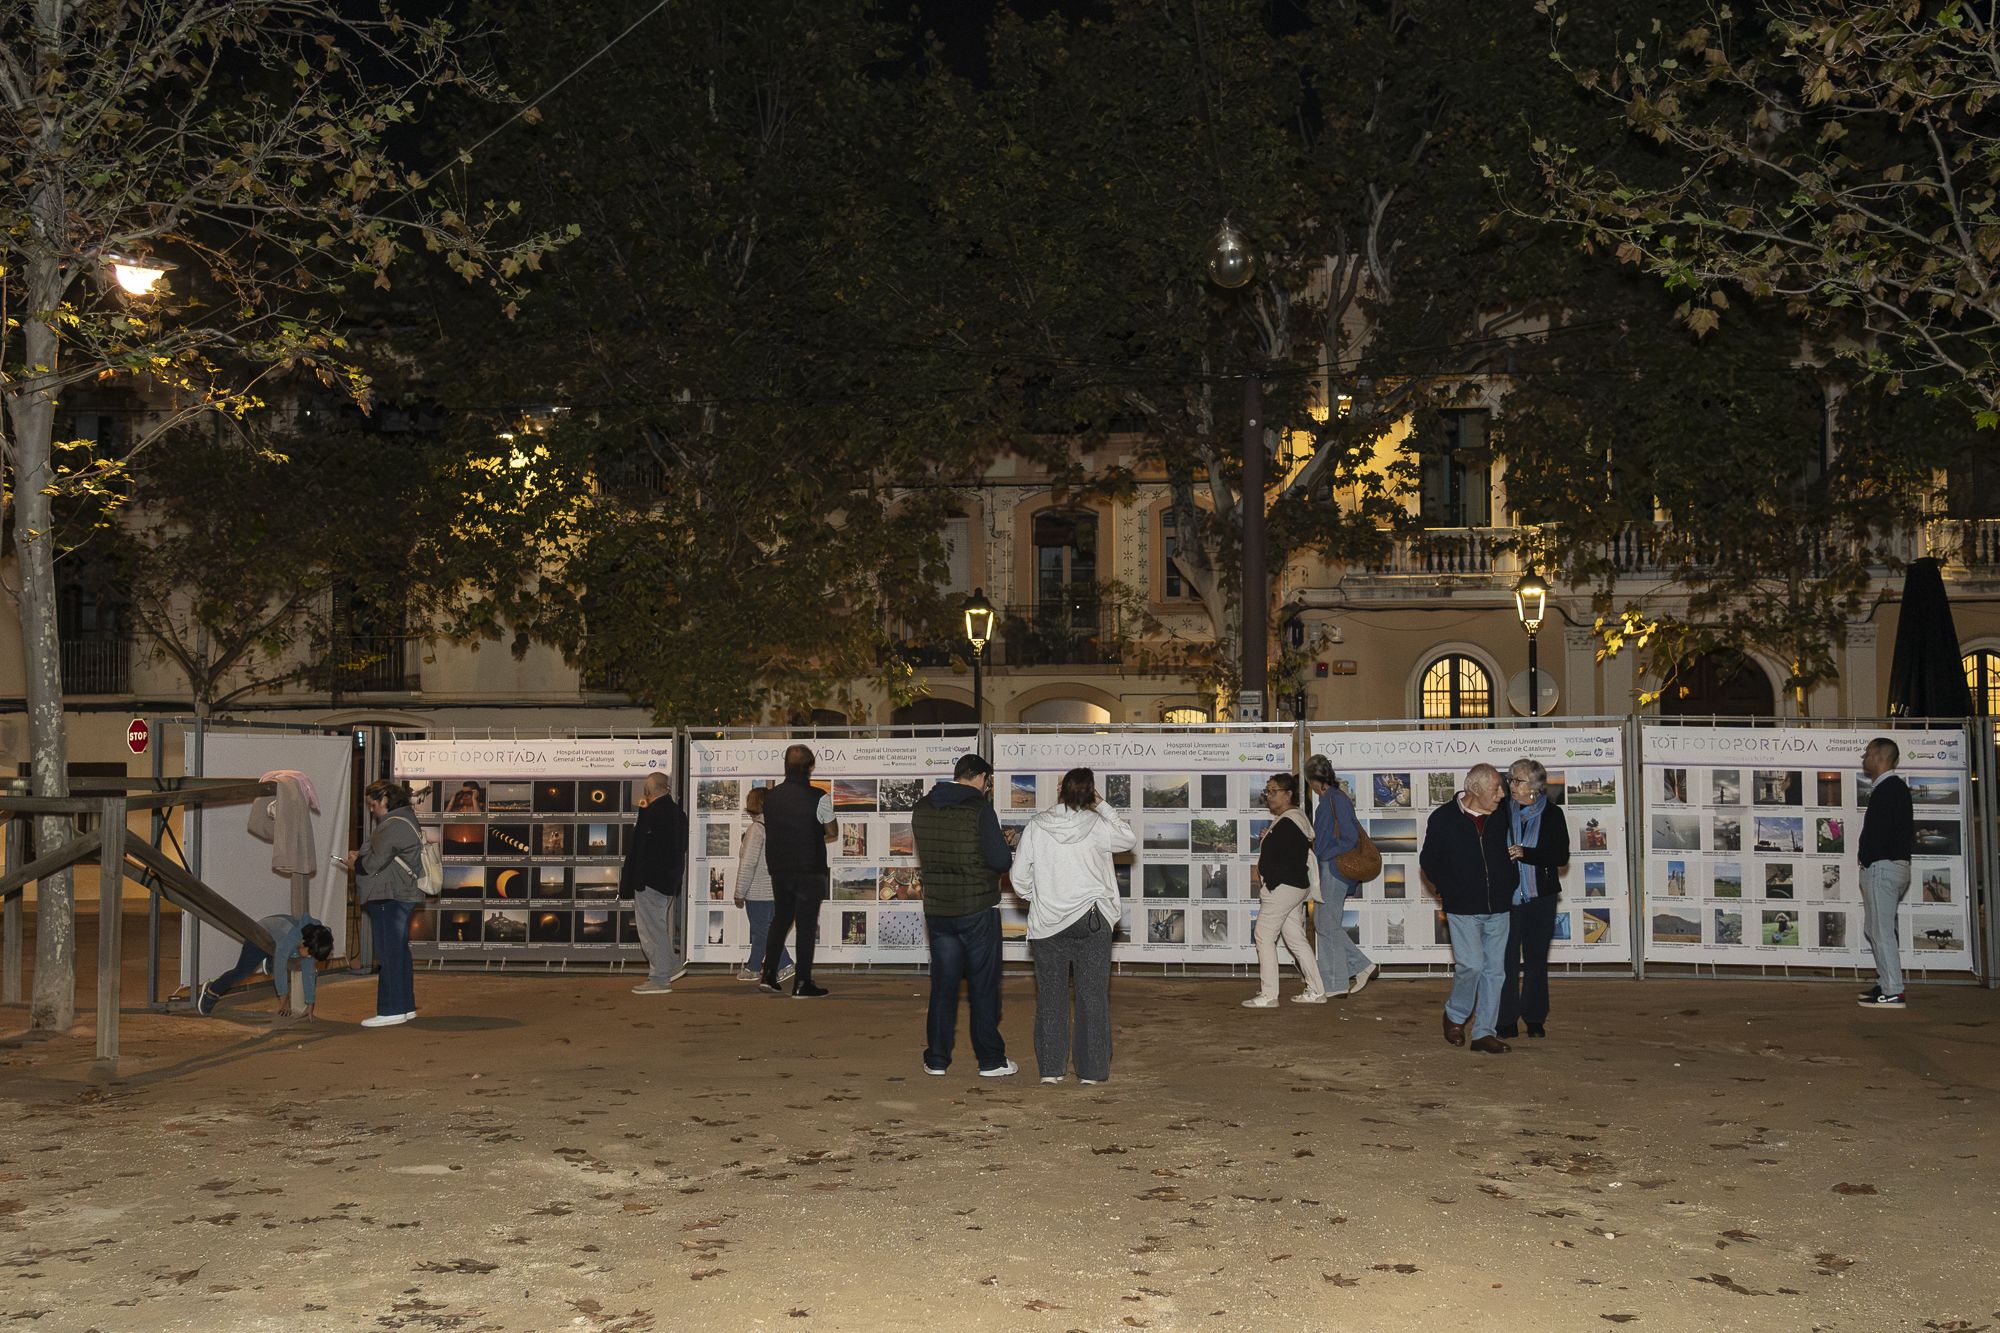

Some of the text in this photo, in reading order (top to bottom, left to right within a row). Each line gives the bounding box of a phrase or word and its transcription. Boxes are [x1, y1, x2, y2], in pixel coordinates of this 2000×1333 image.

[130, 732, 147, 741] STOP
[1650, 737, 1818, 752] TOT FOTOPORTADA
[1829, 738, 1858, 746] Hospital
[556, 749, 580, 757] Hospital
[856, 747, 880, 755] Hospital
[1000, 743, 1156, 756] TOT FOTOPORTADA
[1197, 749, 1230, 757] Catalunya
[1318, 741, 1480, 755] TOT FOTOPORTADA
[402, 751, 546, 762] TOT FOTOPORTADA
[697, 749, 847, 761] TOT FOTOPADA
